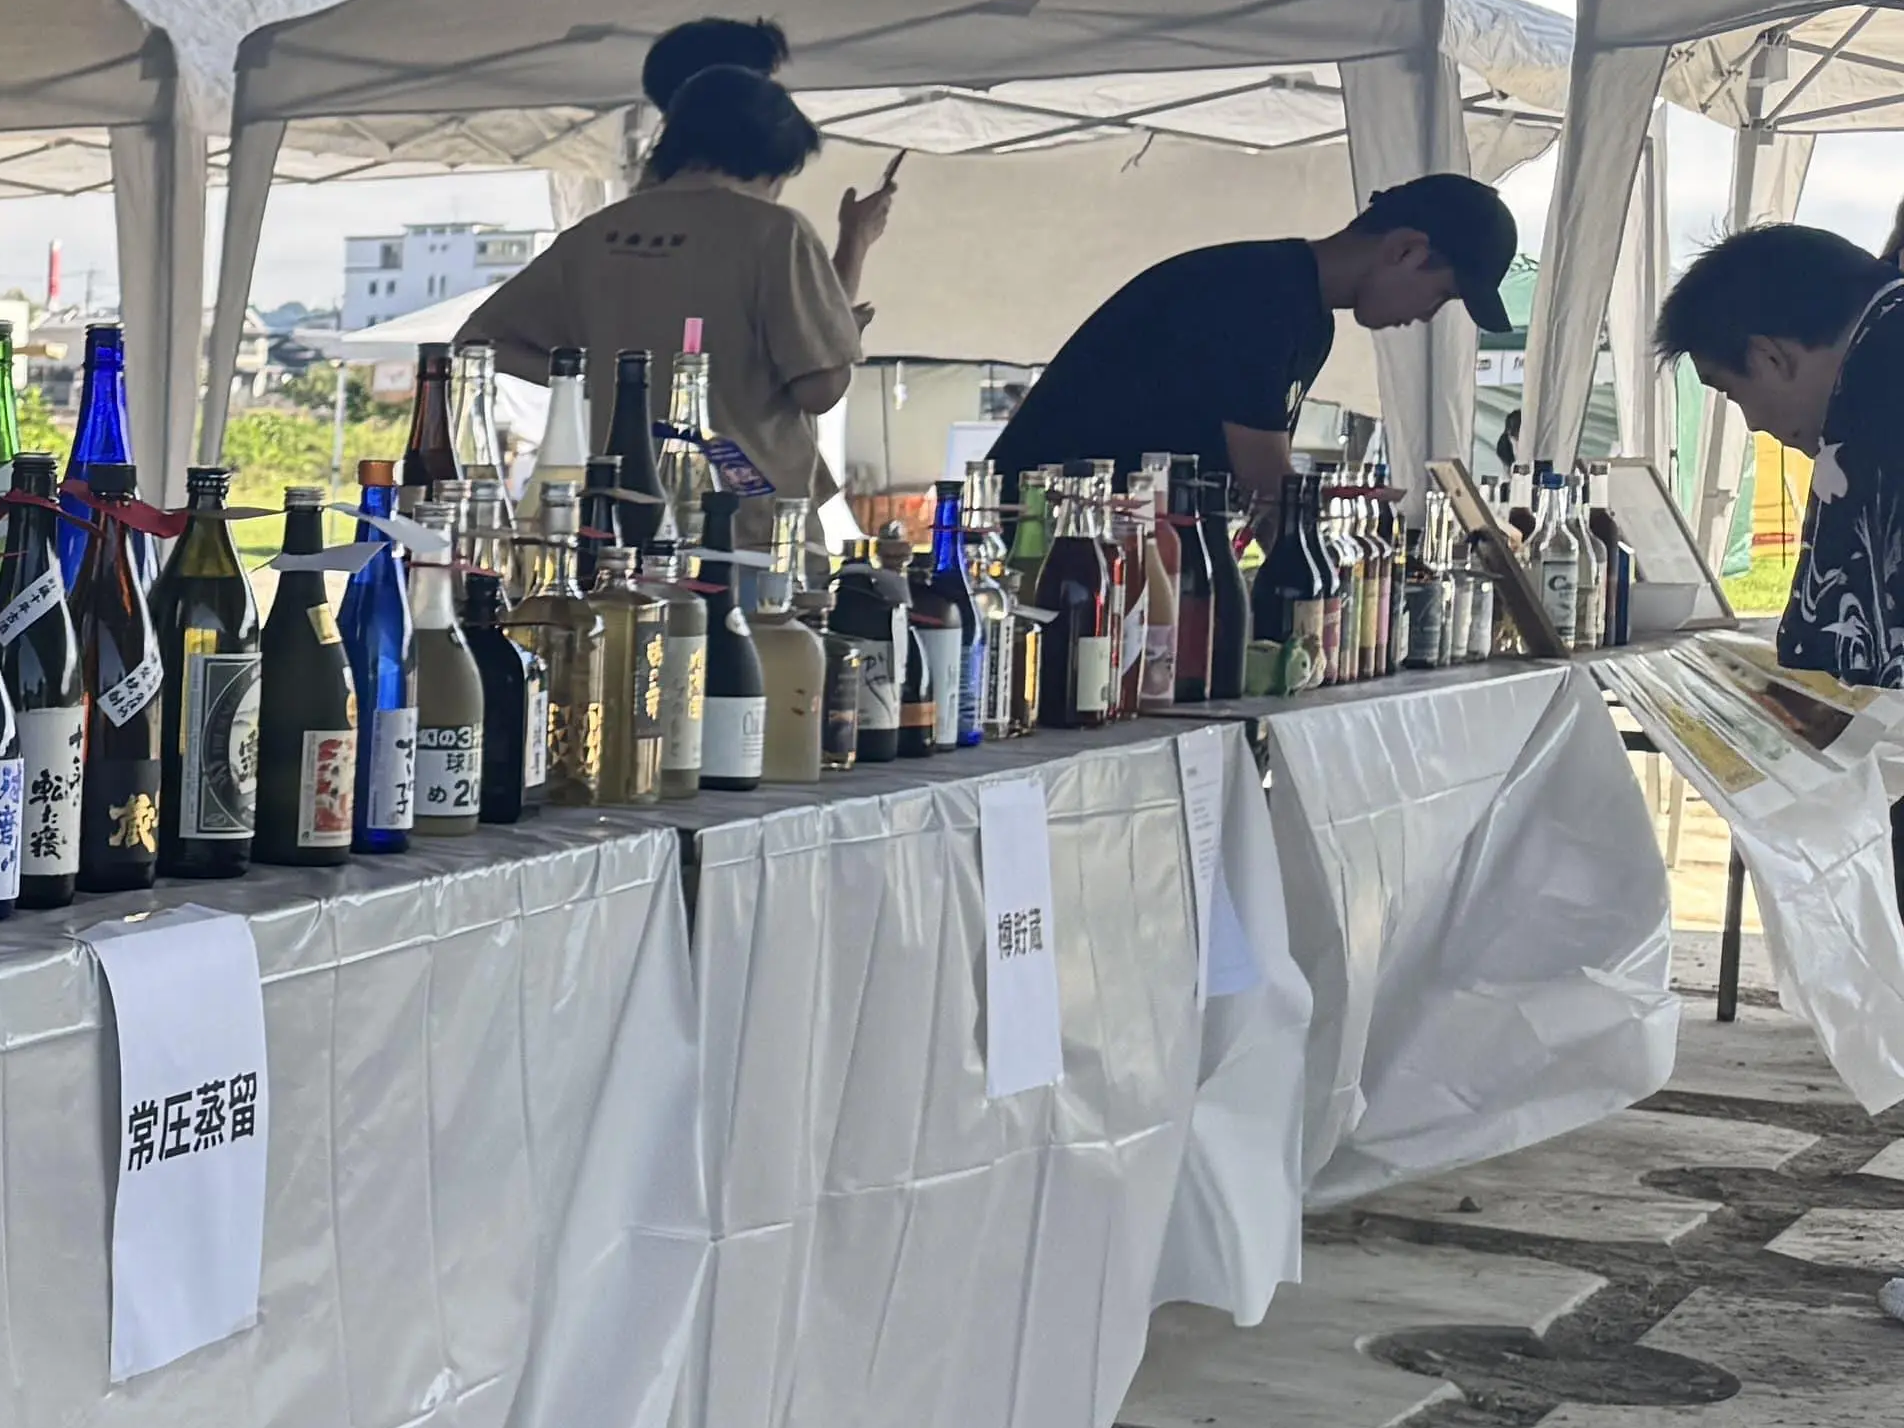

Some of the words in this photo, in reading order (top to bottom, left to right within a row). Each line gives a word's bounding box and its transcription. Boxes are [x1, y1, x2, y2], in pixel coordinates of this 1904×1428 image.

[997, 907, 1044, 961] 樽貯蔵
[127, 1071, 258, 1172] 常圧蒸留
